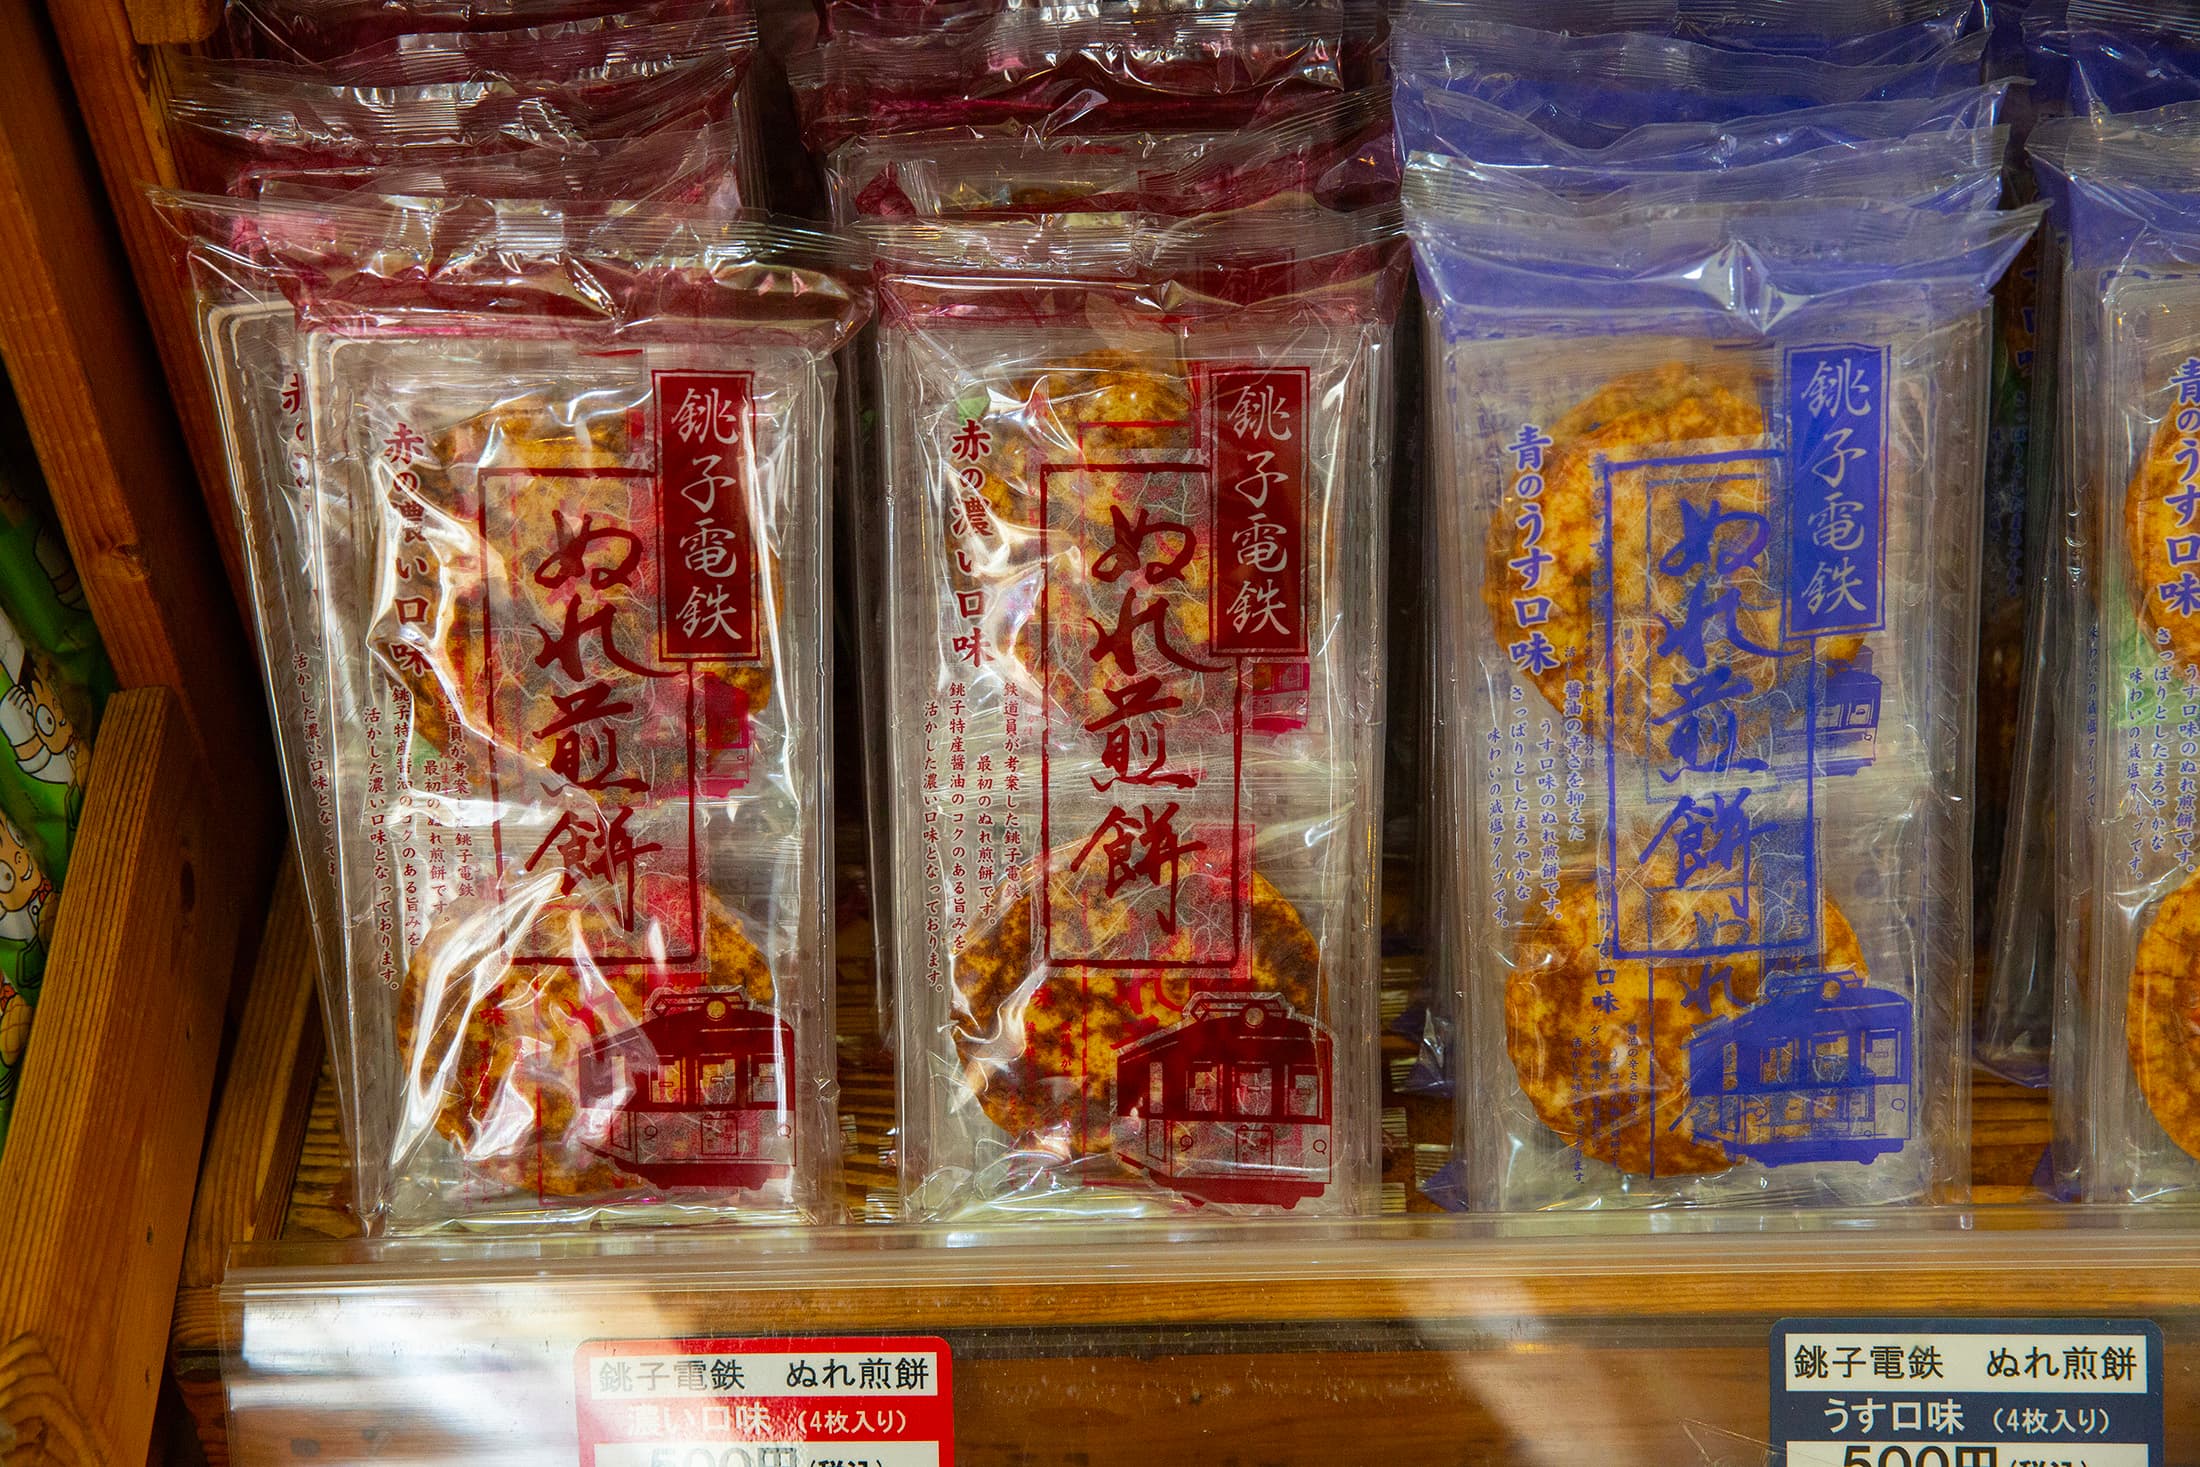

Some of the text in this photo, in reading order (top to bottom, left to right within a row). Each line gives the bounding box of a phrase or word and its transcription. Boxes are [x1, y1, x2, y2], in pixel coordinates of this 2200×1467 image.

[671, 387, 743, 640] 銚子電鉄
[1227, 384, 1293, 637] 銚子電鉄
[1508, 425, 1560, 674] 青のうす口味
[1801, 357, 1871, 617] 銚子電鉄
[525, 509, 688, 932] ぬれ煎餅
[1003, 682, 1021, 900] 鉄道員が考案した銚子電鉄
[1069, 503, 1231, 936] ぬれ煎餅
[1510, 686, 1532, 901] さっぱりとしたまろやかな
[1538, 719, 1563, 921] うす口味のぬれ煎餅です。
[1565, 680, 1586, 842] 醤油の辛さを抑えた
[1639, 500, 1804, 918] ぬれ煎餅
[2151, 628, 2174, 851] さっぱりとしたまろやかな
[363, 707, 399, 991] 活かした濃い口味となっております。
[923, 701, 943, 993] 活かした濃い口味となっております。
[976, 754, 996, 926] 最初のぬれ煎餅です。
[600, 1357, 930, 1391] 銚子電鉄 ぬれ煎餅
[1794, 1344, 2137, 1381] 銚子電鉄 ぬれ煎餅
[1824, 1398, 1966, 1435] うす口味
